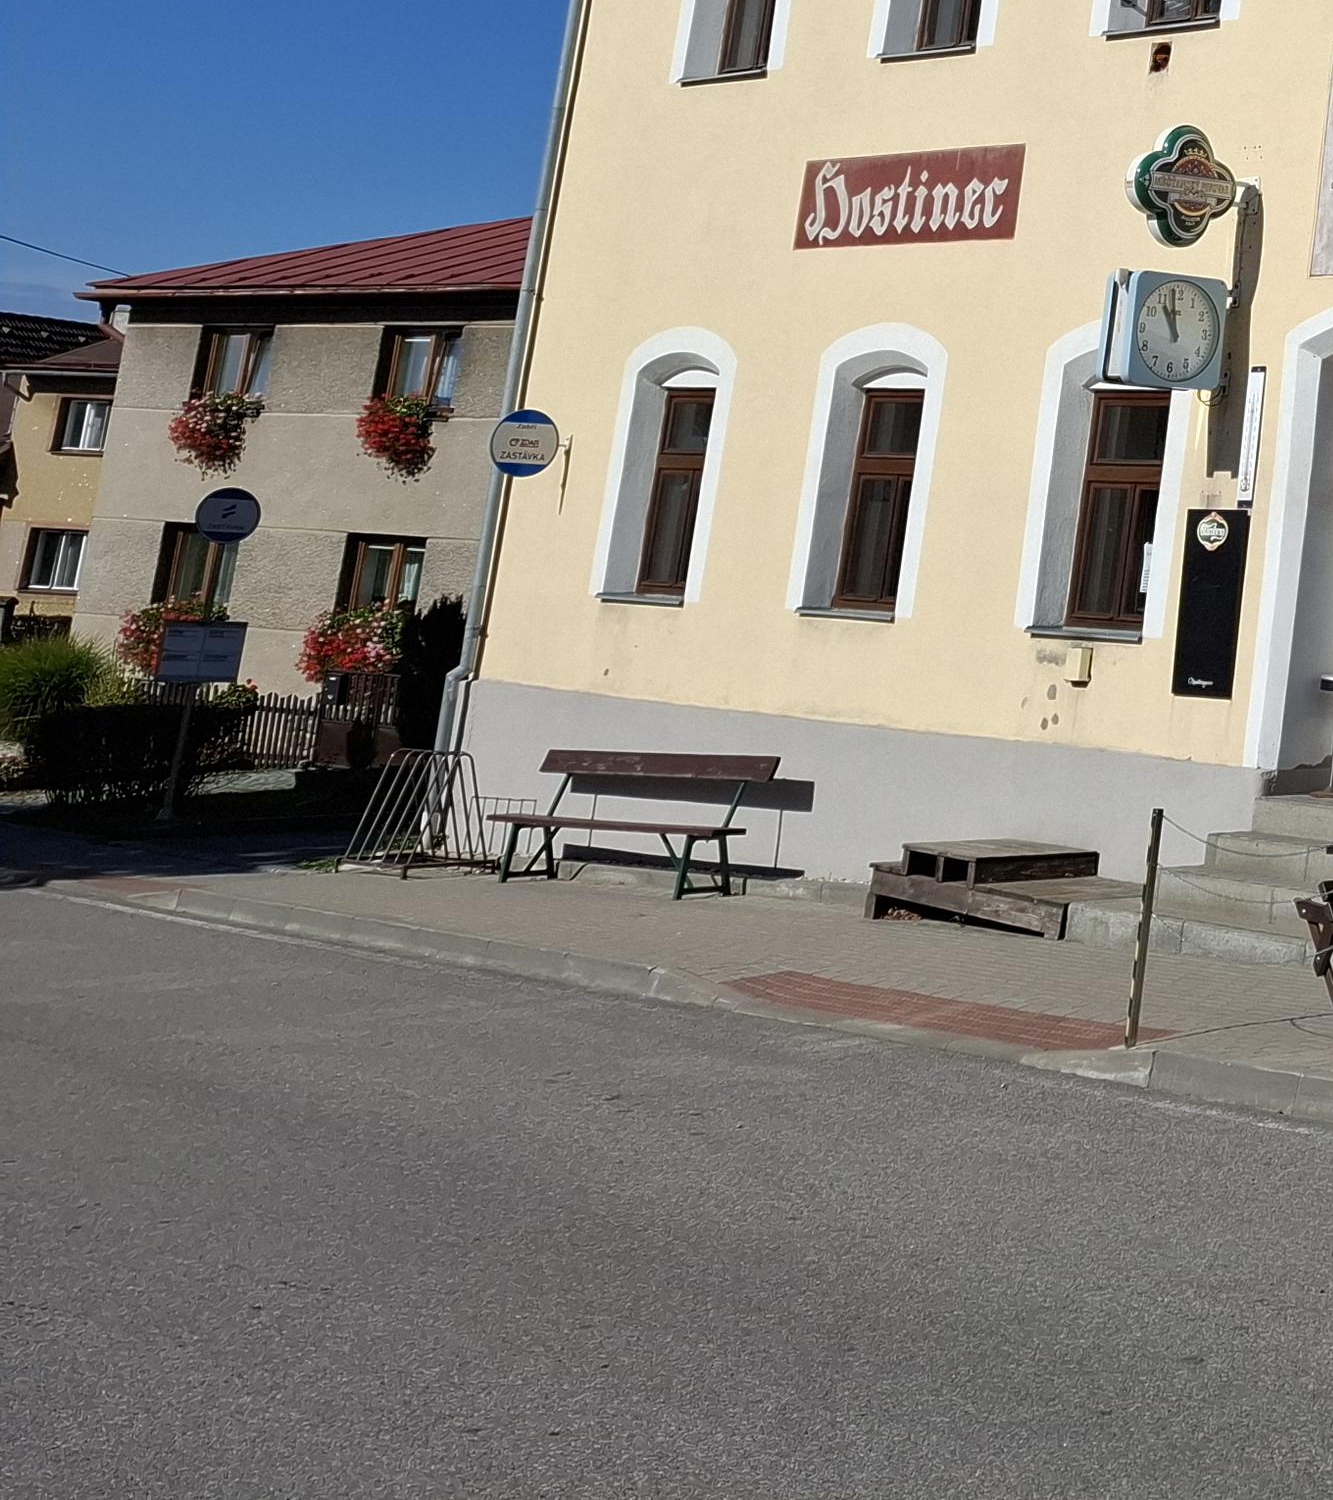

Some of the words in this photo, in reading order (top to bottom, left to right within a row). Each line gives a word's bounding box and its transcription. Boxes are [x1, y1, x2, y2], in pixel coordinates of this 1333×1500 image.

[804, 161, 1009, 246] Hostinec
[1146, 305, 1157, 317] 10
[1198, 311, 1205, 322] 2
[1139, 322, 1146, 333] 9
[1201, 329, 1208, 340] 3
[1141, 340, 1149, 351] 8
[1194, 346, 1201, 358] 4
[1152, 355, 1159, 367] 7
[1167, 361, 1173, 373] 6
[1183, 358, 1190, 370] 5
[499, 450, 545, 461] ZASTÁVKA
